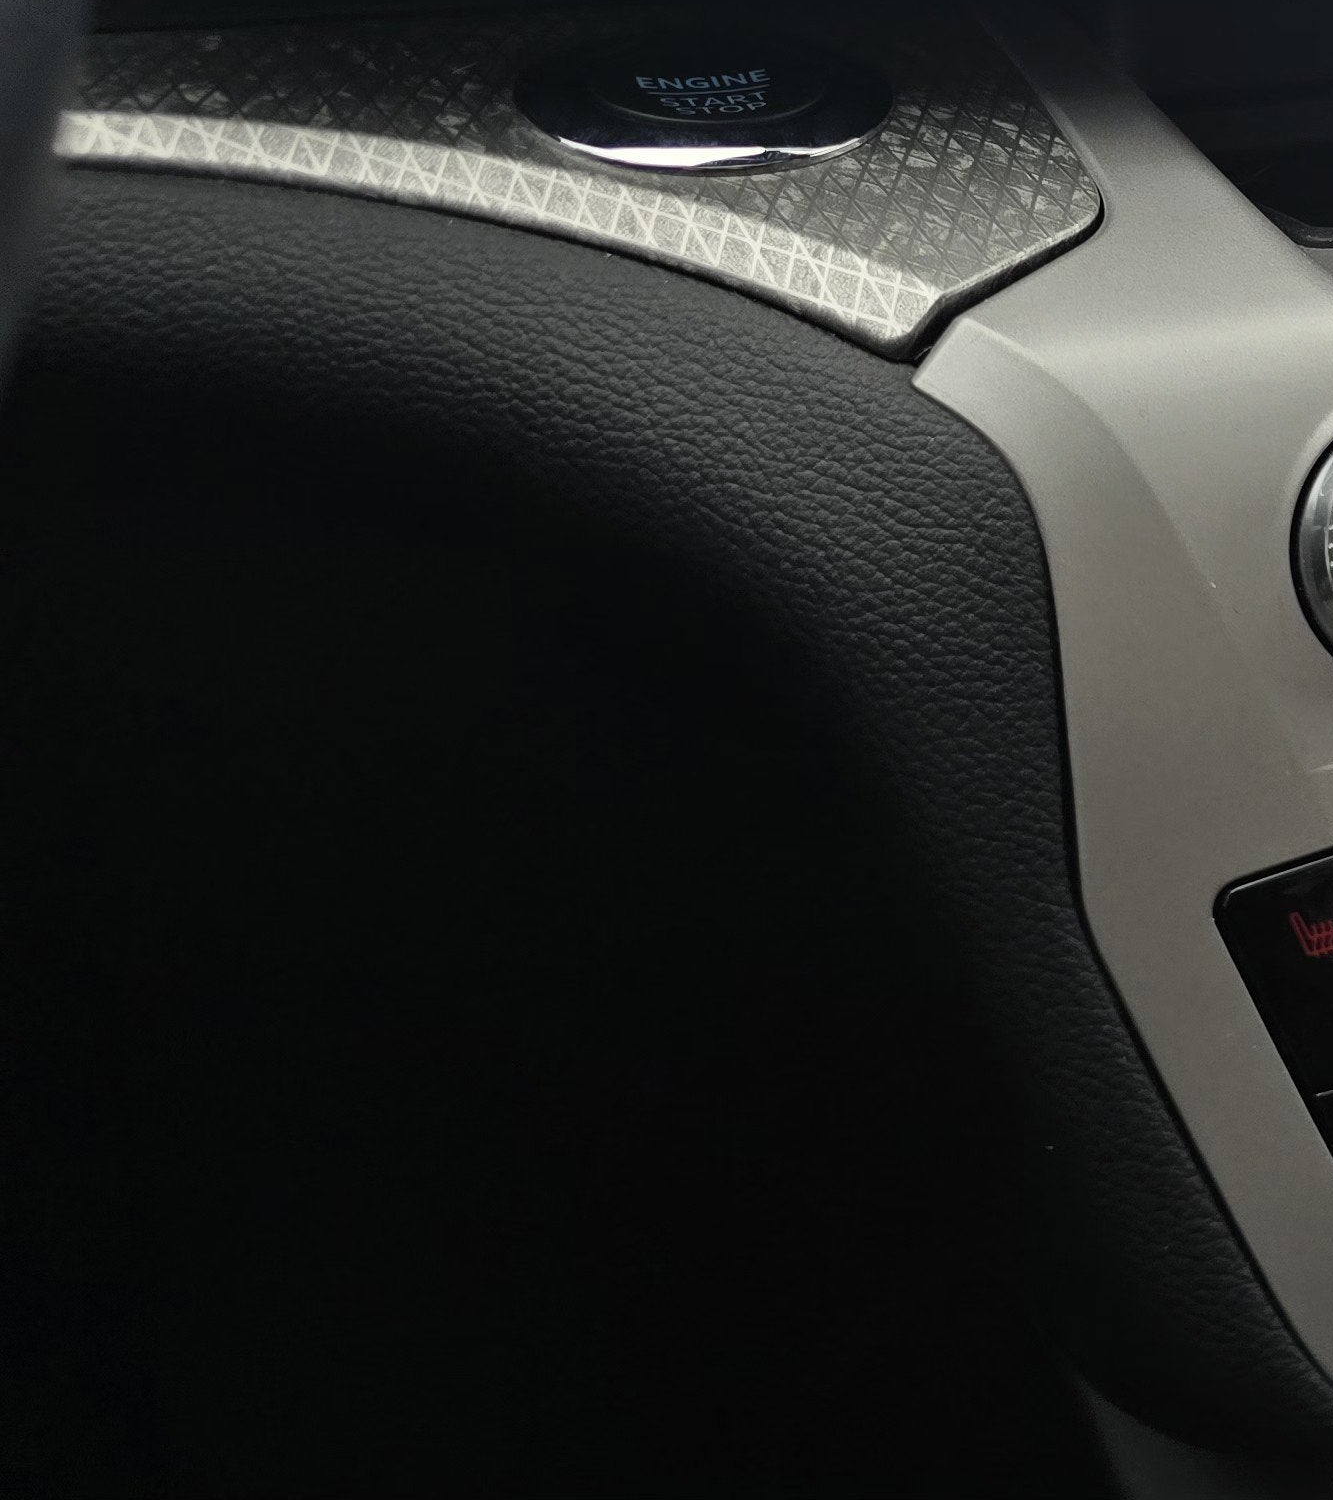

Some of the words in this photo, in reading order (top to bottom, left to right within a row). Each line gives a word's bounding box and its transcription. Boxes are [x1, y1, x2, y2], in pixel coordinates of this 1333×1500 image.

[635, 68, 771, 90] ENGINE
[660, 91, 767, 107] START
[675, 101, 767, 115] STOP
